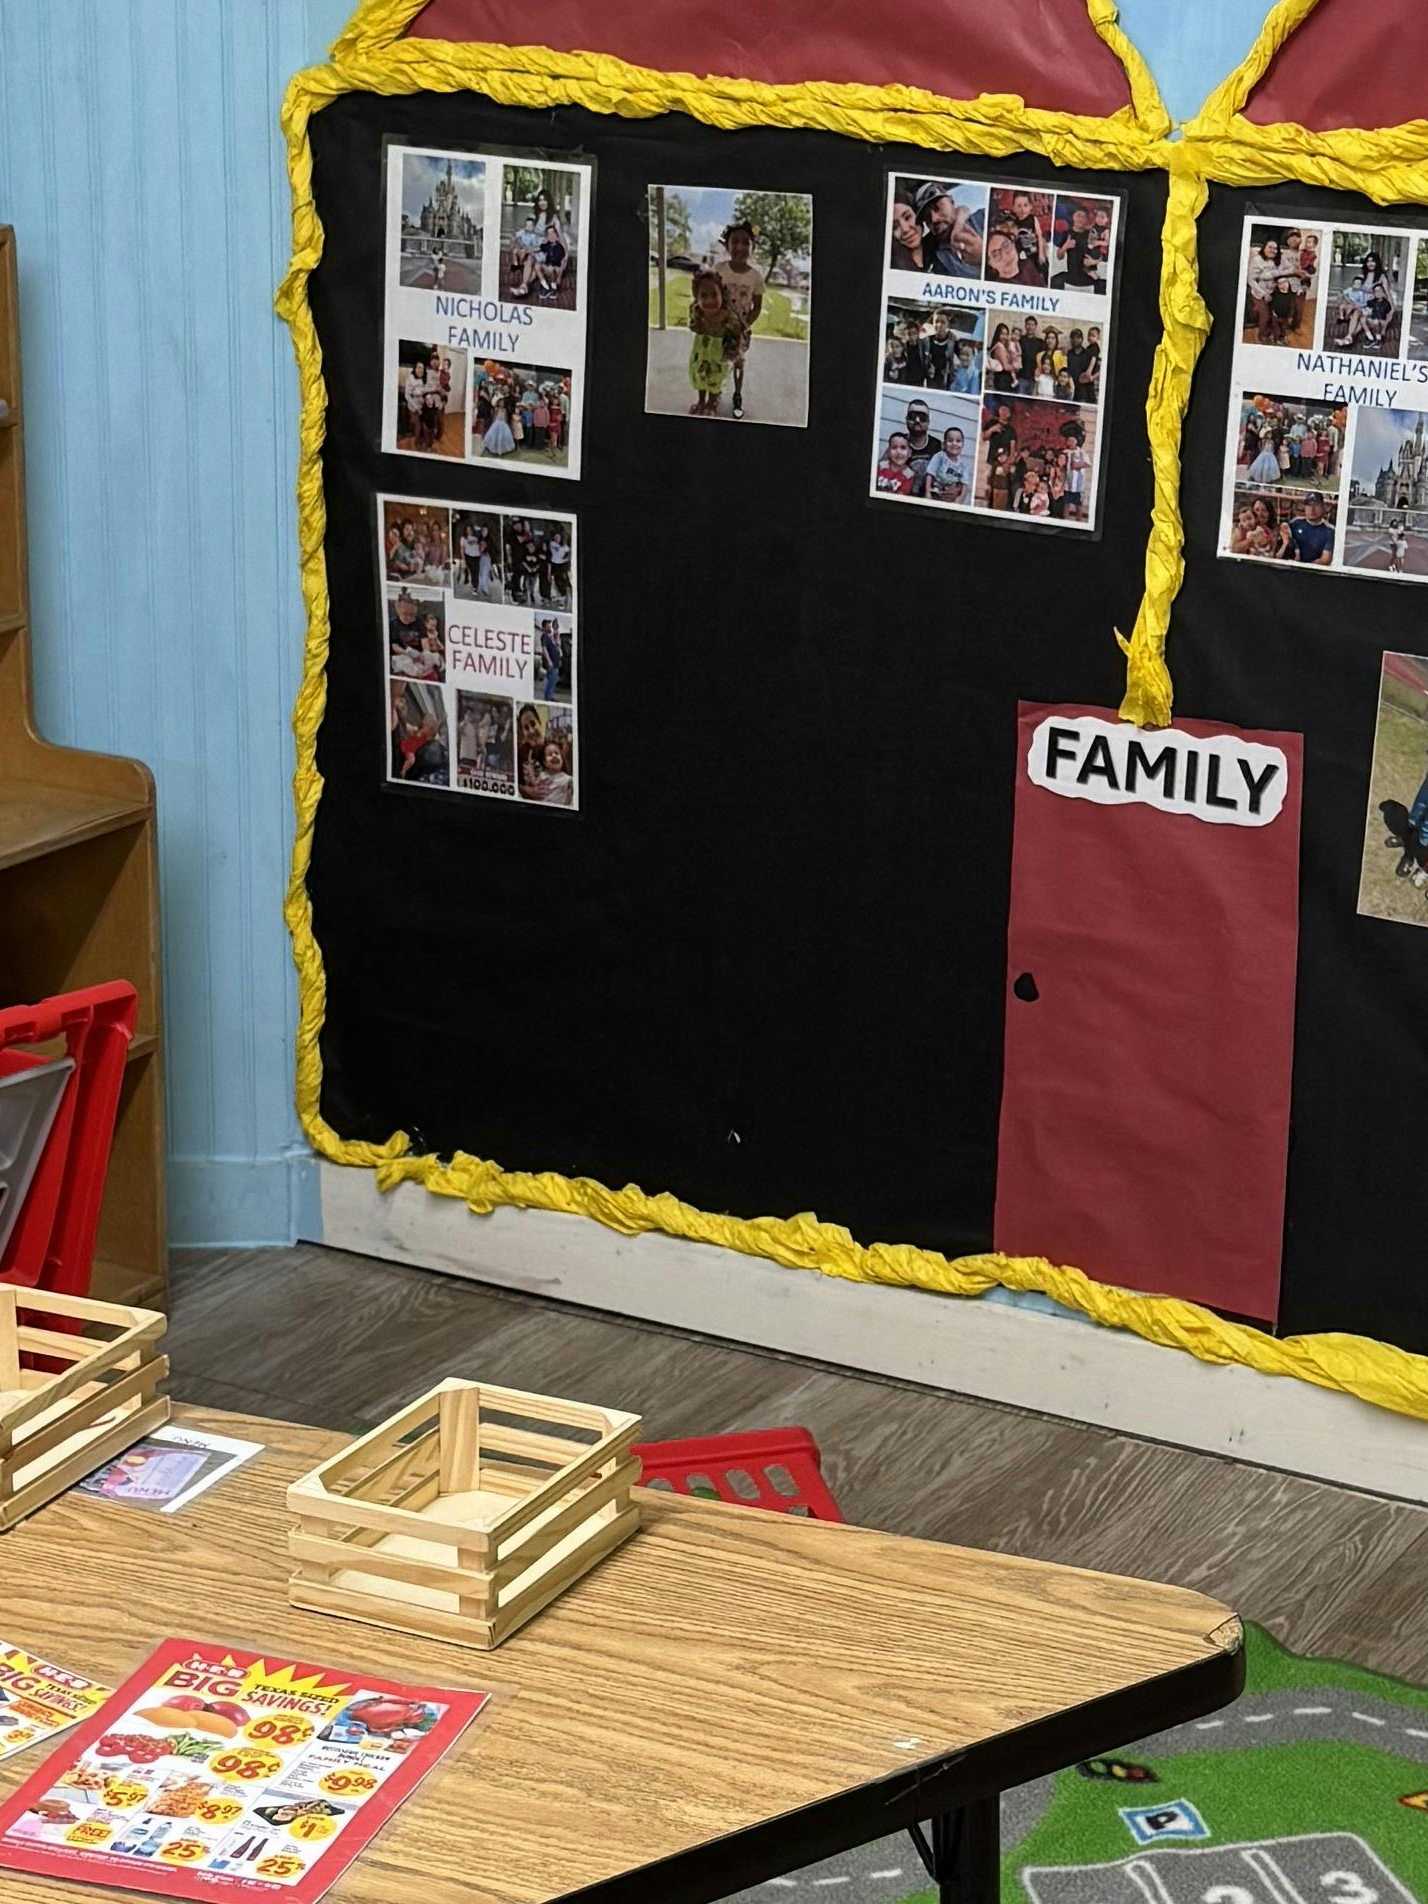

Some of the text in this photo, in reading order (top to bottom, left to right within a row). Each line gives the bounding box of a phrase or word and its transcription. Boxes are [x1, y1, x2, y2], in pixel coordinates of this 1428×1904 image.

[436, 296, 533, 326] NICHOLAS
[922, 282, 1060, 312] AARON'S FAMILY
[448, 326, 519, 353] FAMILY
[1323, 382, 1397, 408] FAMILY
[448, 624, 532, 655] CELESTE
[453, 650, 528, 680] FAMILY
[1045, 727, 1281, 816] FAMILY
[164, 1670, 243, 1697] BIG
[254, 1683, 295, 1696] TEXAS
[242, 1690, 334, 1717] SAVINGS!
[1145, 1810, 1180, 1831] P
